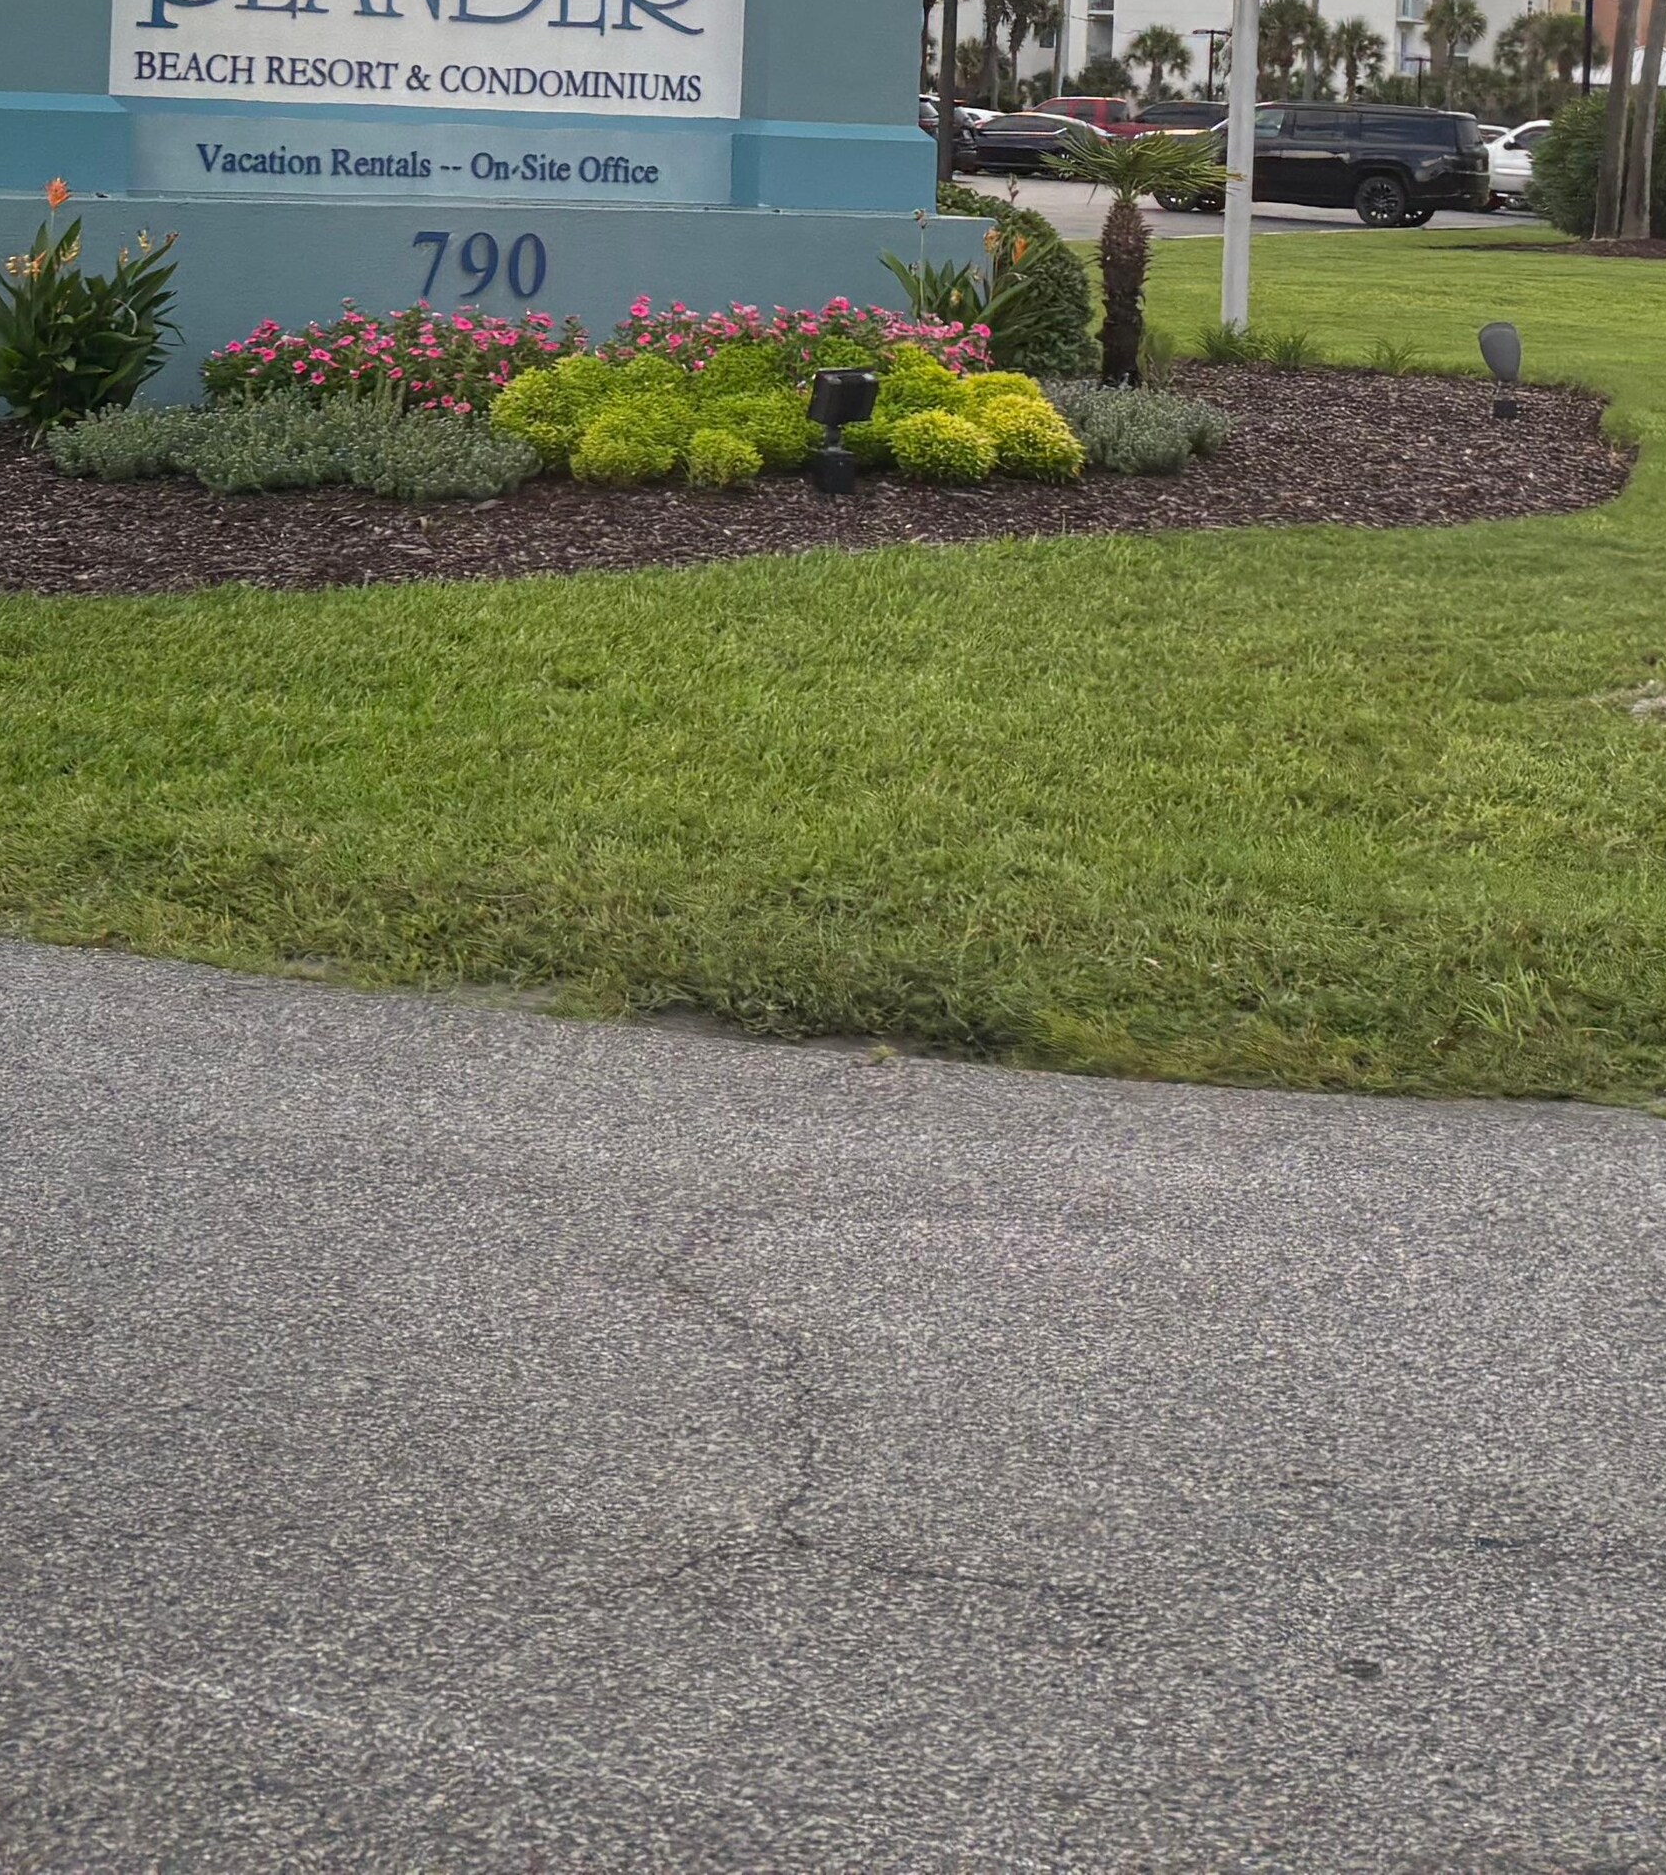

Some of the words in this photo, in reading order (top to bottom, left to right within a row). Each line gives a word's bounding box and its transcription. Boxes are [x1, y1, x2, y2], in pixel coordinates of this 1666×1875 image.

[134, 51, 255, 84] BEACH
[265, 56, 398, 89] RESORT
[406, 64, 431, 91] &
[440, 64, 701, 102] CONDOMINIUMS
[196, 143, 322, 175] Vacation
[331, 148, 431, 177] Rentals
[471, 152, 571, 181] On-Site
[579, 156, 659, 183] Office
[412, 231, 546, 297] 790
